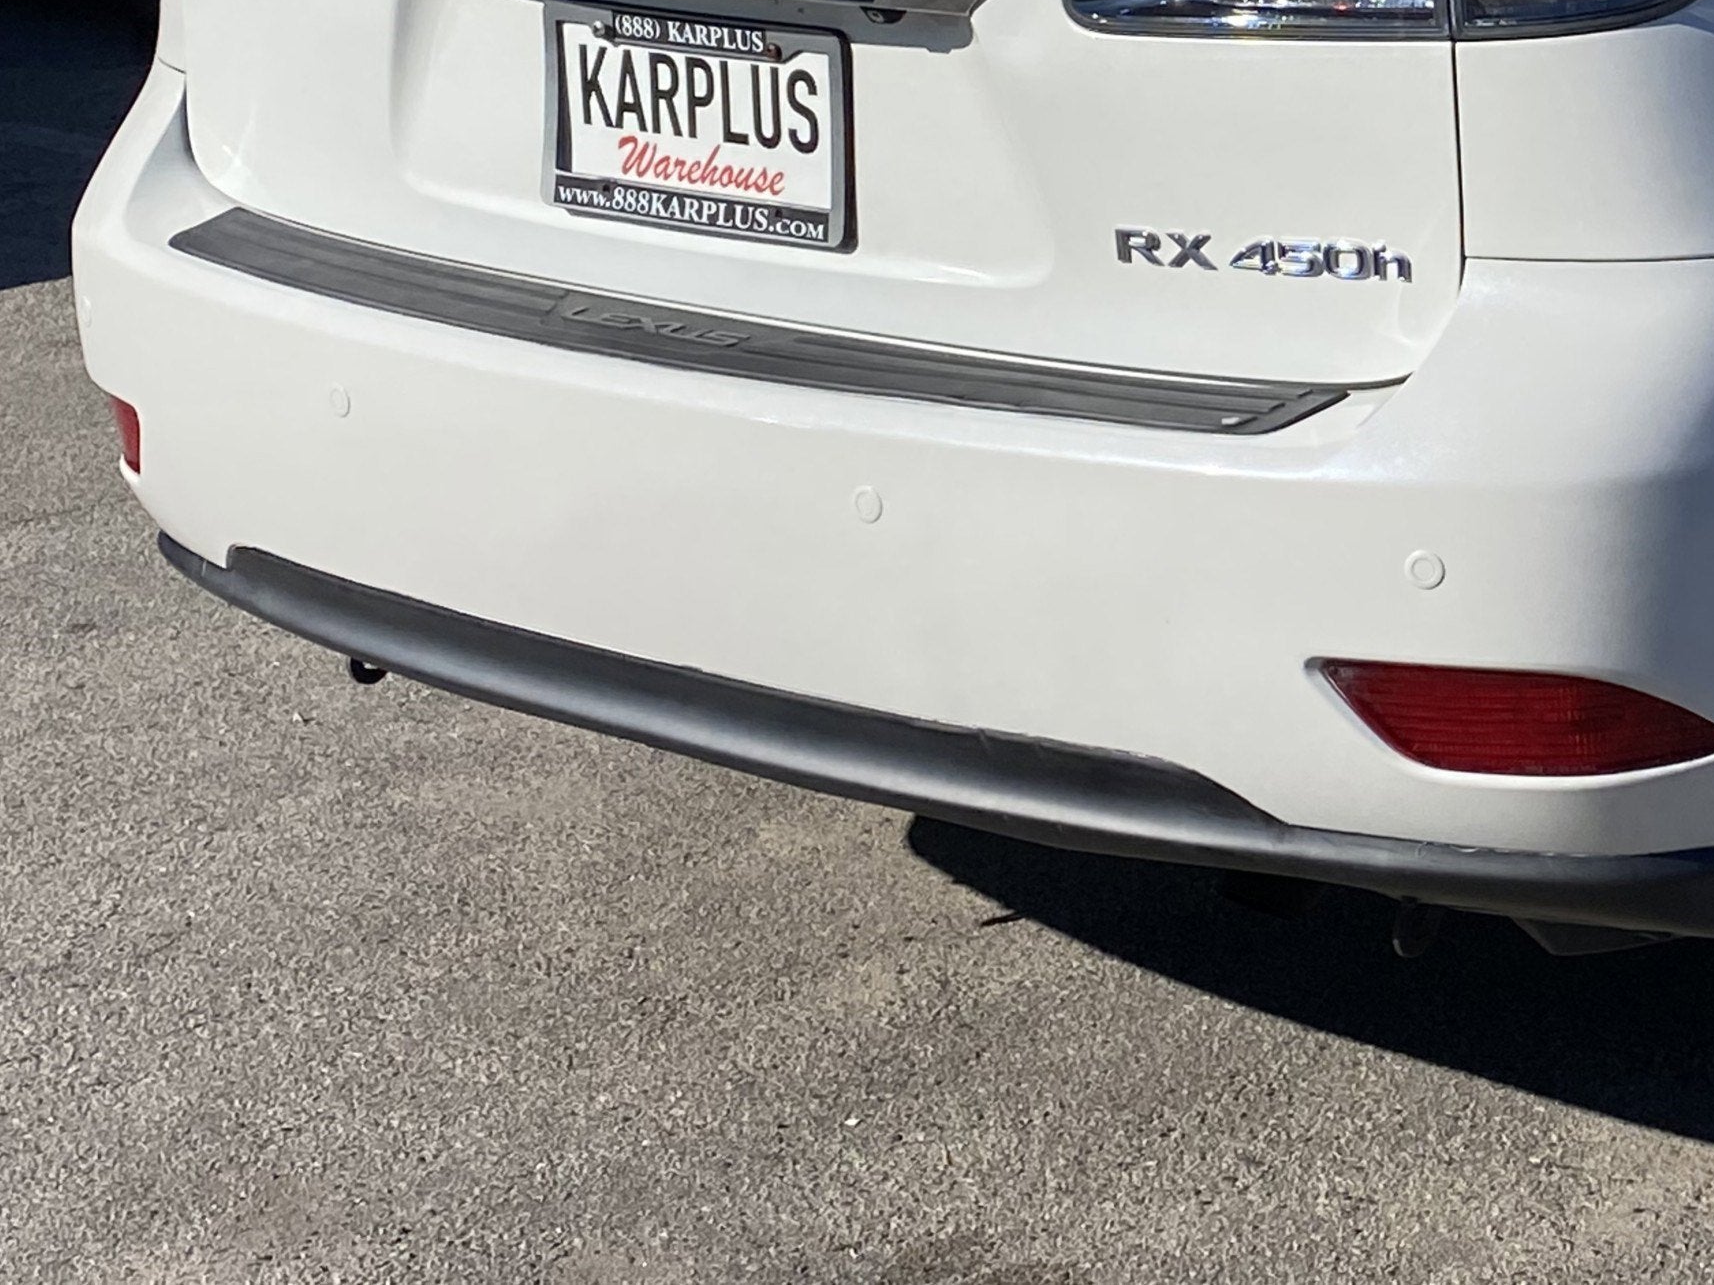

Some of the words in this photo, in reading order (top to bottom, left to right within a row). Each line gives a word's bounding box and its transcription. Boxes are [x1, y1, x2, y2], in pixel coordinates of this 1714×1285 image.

[614, 14, 661, 40] (888)
[667, 21, 764, 53] KARPLUS
[578, 43, 819, 154] KARPLUS
[617, 135, 786, 197] Warehouse
[1114, 224, 1219, 272] RX
[1228, 236, 1413, 284] 450h
